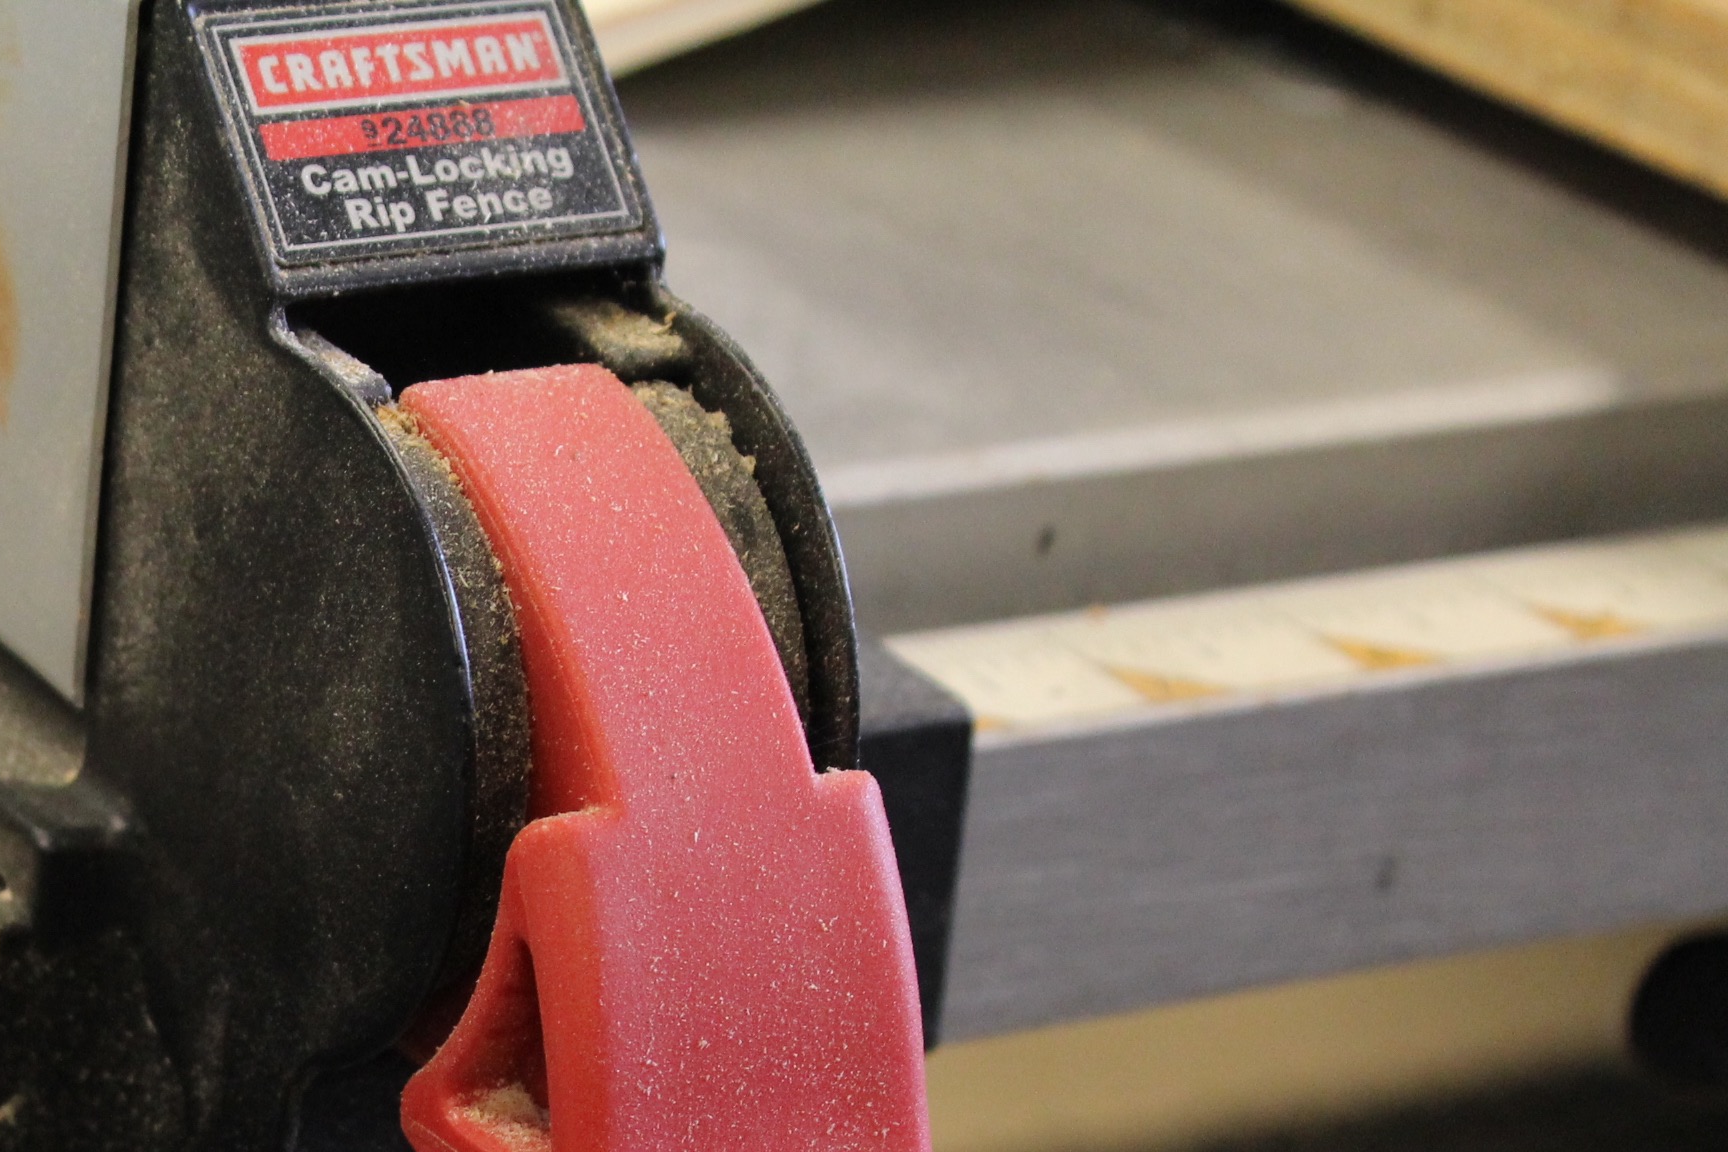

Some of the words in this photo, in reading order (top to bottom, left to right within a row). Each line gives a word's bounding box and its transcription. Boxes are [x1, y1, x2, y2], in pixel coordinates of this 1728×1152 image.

[257, 34, 541, 94] CRAFTSMAN
[301, 145, 573, 197] Cam-Locking
[345, 196, 416, 233] Rip
[425, 184, 554, 222] Fence
